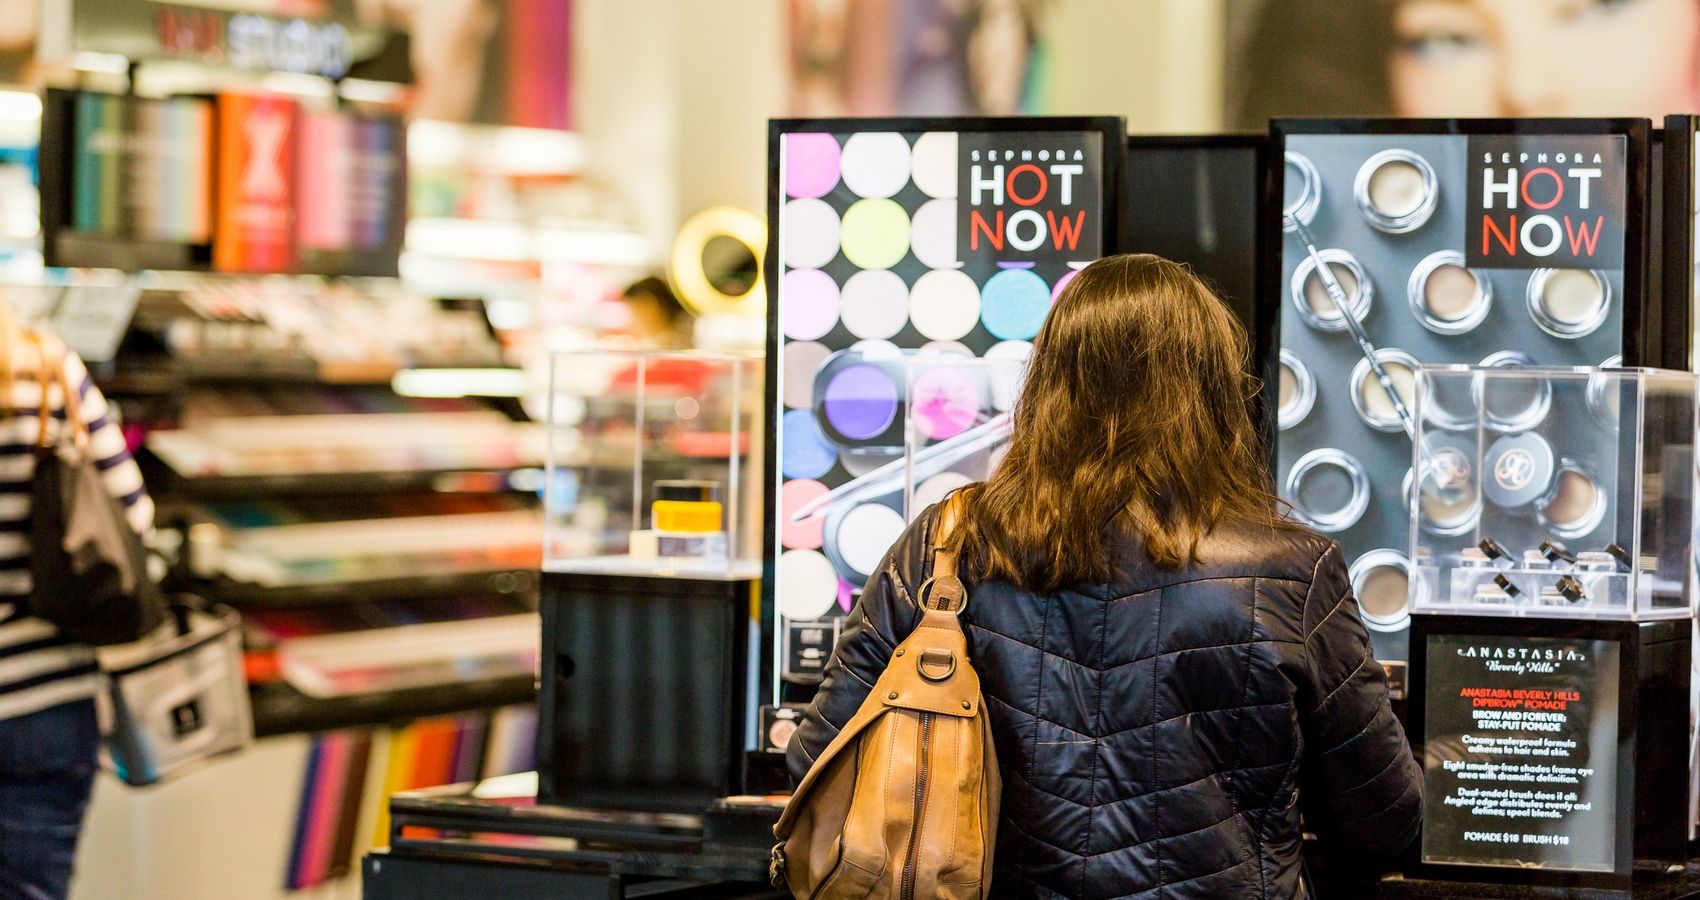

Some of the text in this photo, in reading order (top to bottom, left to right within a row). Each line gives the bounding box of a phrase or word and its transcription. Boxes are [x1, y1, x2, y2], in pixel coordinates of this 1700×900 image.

[971, 149, 1084, 162] SEPHORA
[1484, 152, 1602, 164] SEPHORA
[970, 163, 1084, 207] HOT
[1483, 167, 1602, 210] HOT
[970, 209, 1086, 252] NOW
[1482, 214, 1604, 257] NOW
[1457, 646, 1585, 661] ANASTASIA
[1486, 660, 1525, 675] Beverly
[1460, 687, 1581, 702] ANASTASIA BEVERLY HILLS
[1525, 699, 1567, 710] POMADE
[1472, 710, 1502, 720] BROW
[1502, 711, 1522, 721] AND
[1478, 721, 1561, 732] STAY-PUT POMADE
[1461, 734, 1577, 749] Creamy waterproof formula
[1467, 745, 1503, 755] adheres
[1504, 746, 1513, 755] to
[1514, 746, 1531, 755] hair
[1532, 747, 1550, 756] and
[1443, 760, 1465, 772] Eight
[1520, 763, 1551, 774] shades
[1551, 765, 1577, 775] frame
[1577, 768, 1594, 777] eye
[1457, 772, 1478, 780] area
[1479, 771, 1497, 781] with
[1497, 771, 1535, 782] dramatic
[1509, 789, 1533, 799] brush
[1534, 790, 1555, 800] does
[1556, 791, 1563, 801] it
[1444, 795, 1591, 812] Angled edge distributes evenly and
[1464, 831, 1502, 842] POMADE
[1522, 833, 1551, 844] BRUSH
